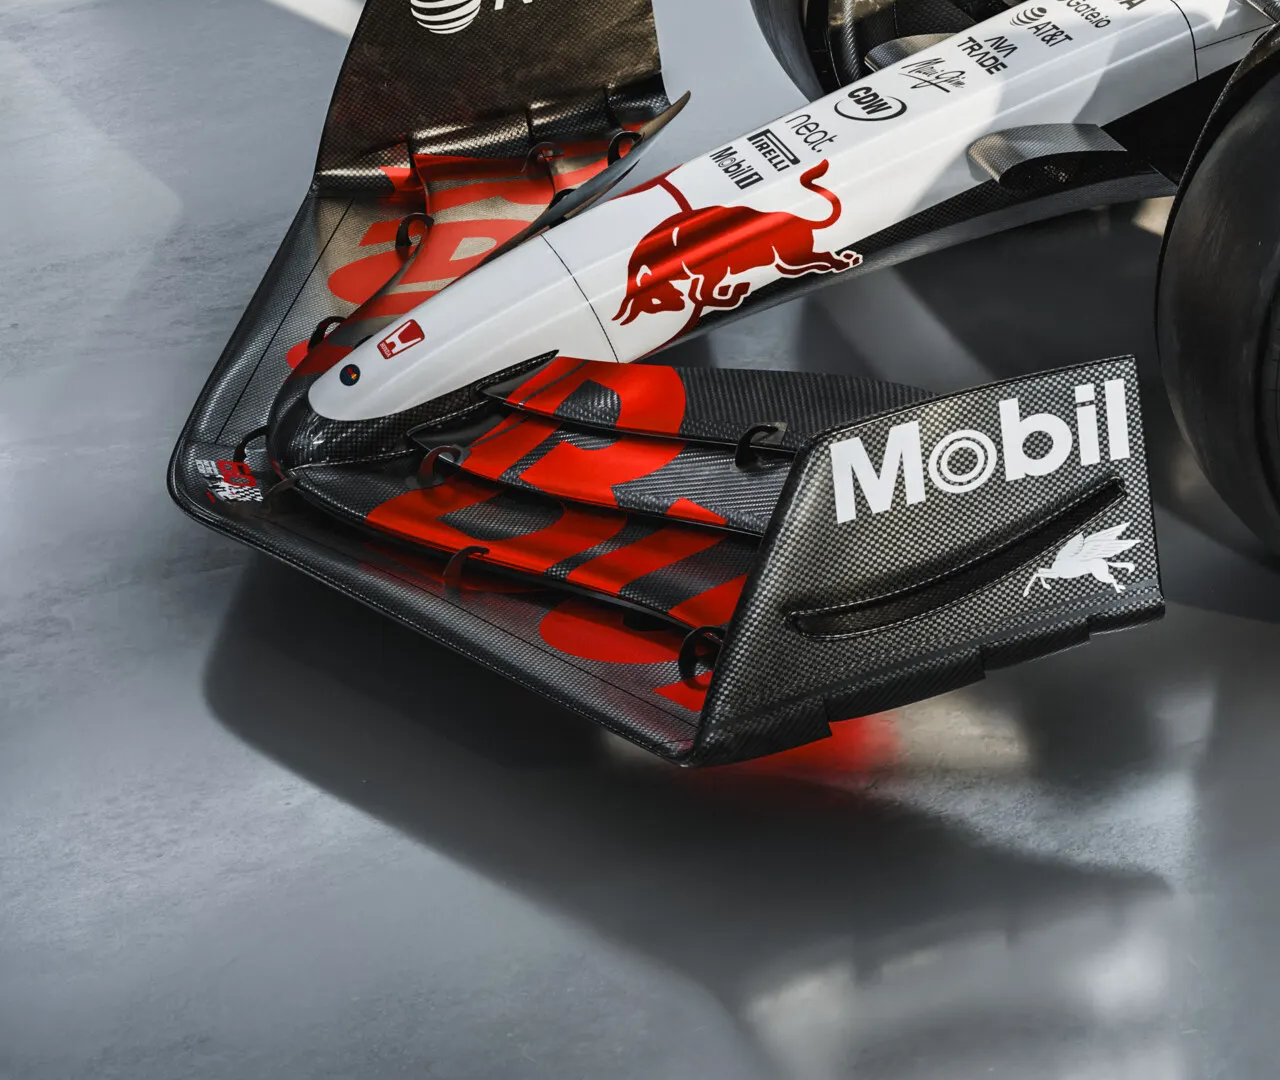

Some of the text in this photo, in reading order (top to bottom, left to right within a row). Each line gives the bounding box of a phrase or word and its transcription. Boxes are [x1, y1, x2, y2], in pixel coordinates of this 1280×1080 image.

[984, 35, 1019, 58] AVA
[1027, 20, 1074, 48] AT&T
[957, 36, 1008, 76] TRADE
[848, 86, 893, 115] CDW
[747, 128, 801, 172] PIRELLI
[785, 114, 840, 153] neat.
[709, 146, 753, 181] Mobil
[830, 378, 1131, 524] Mobil
